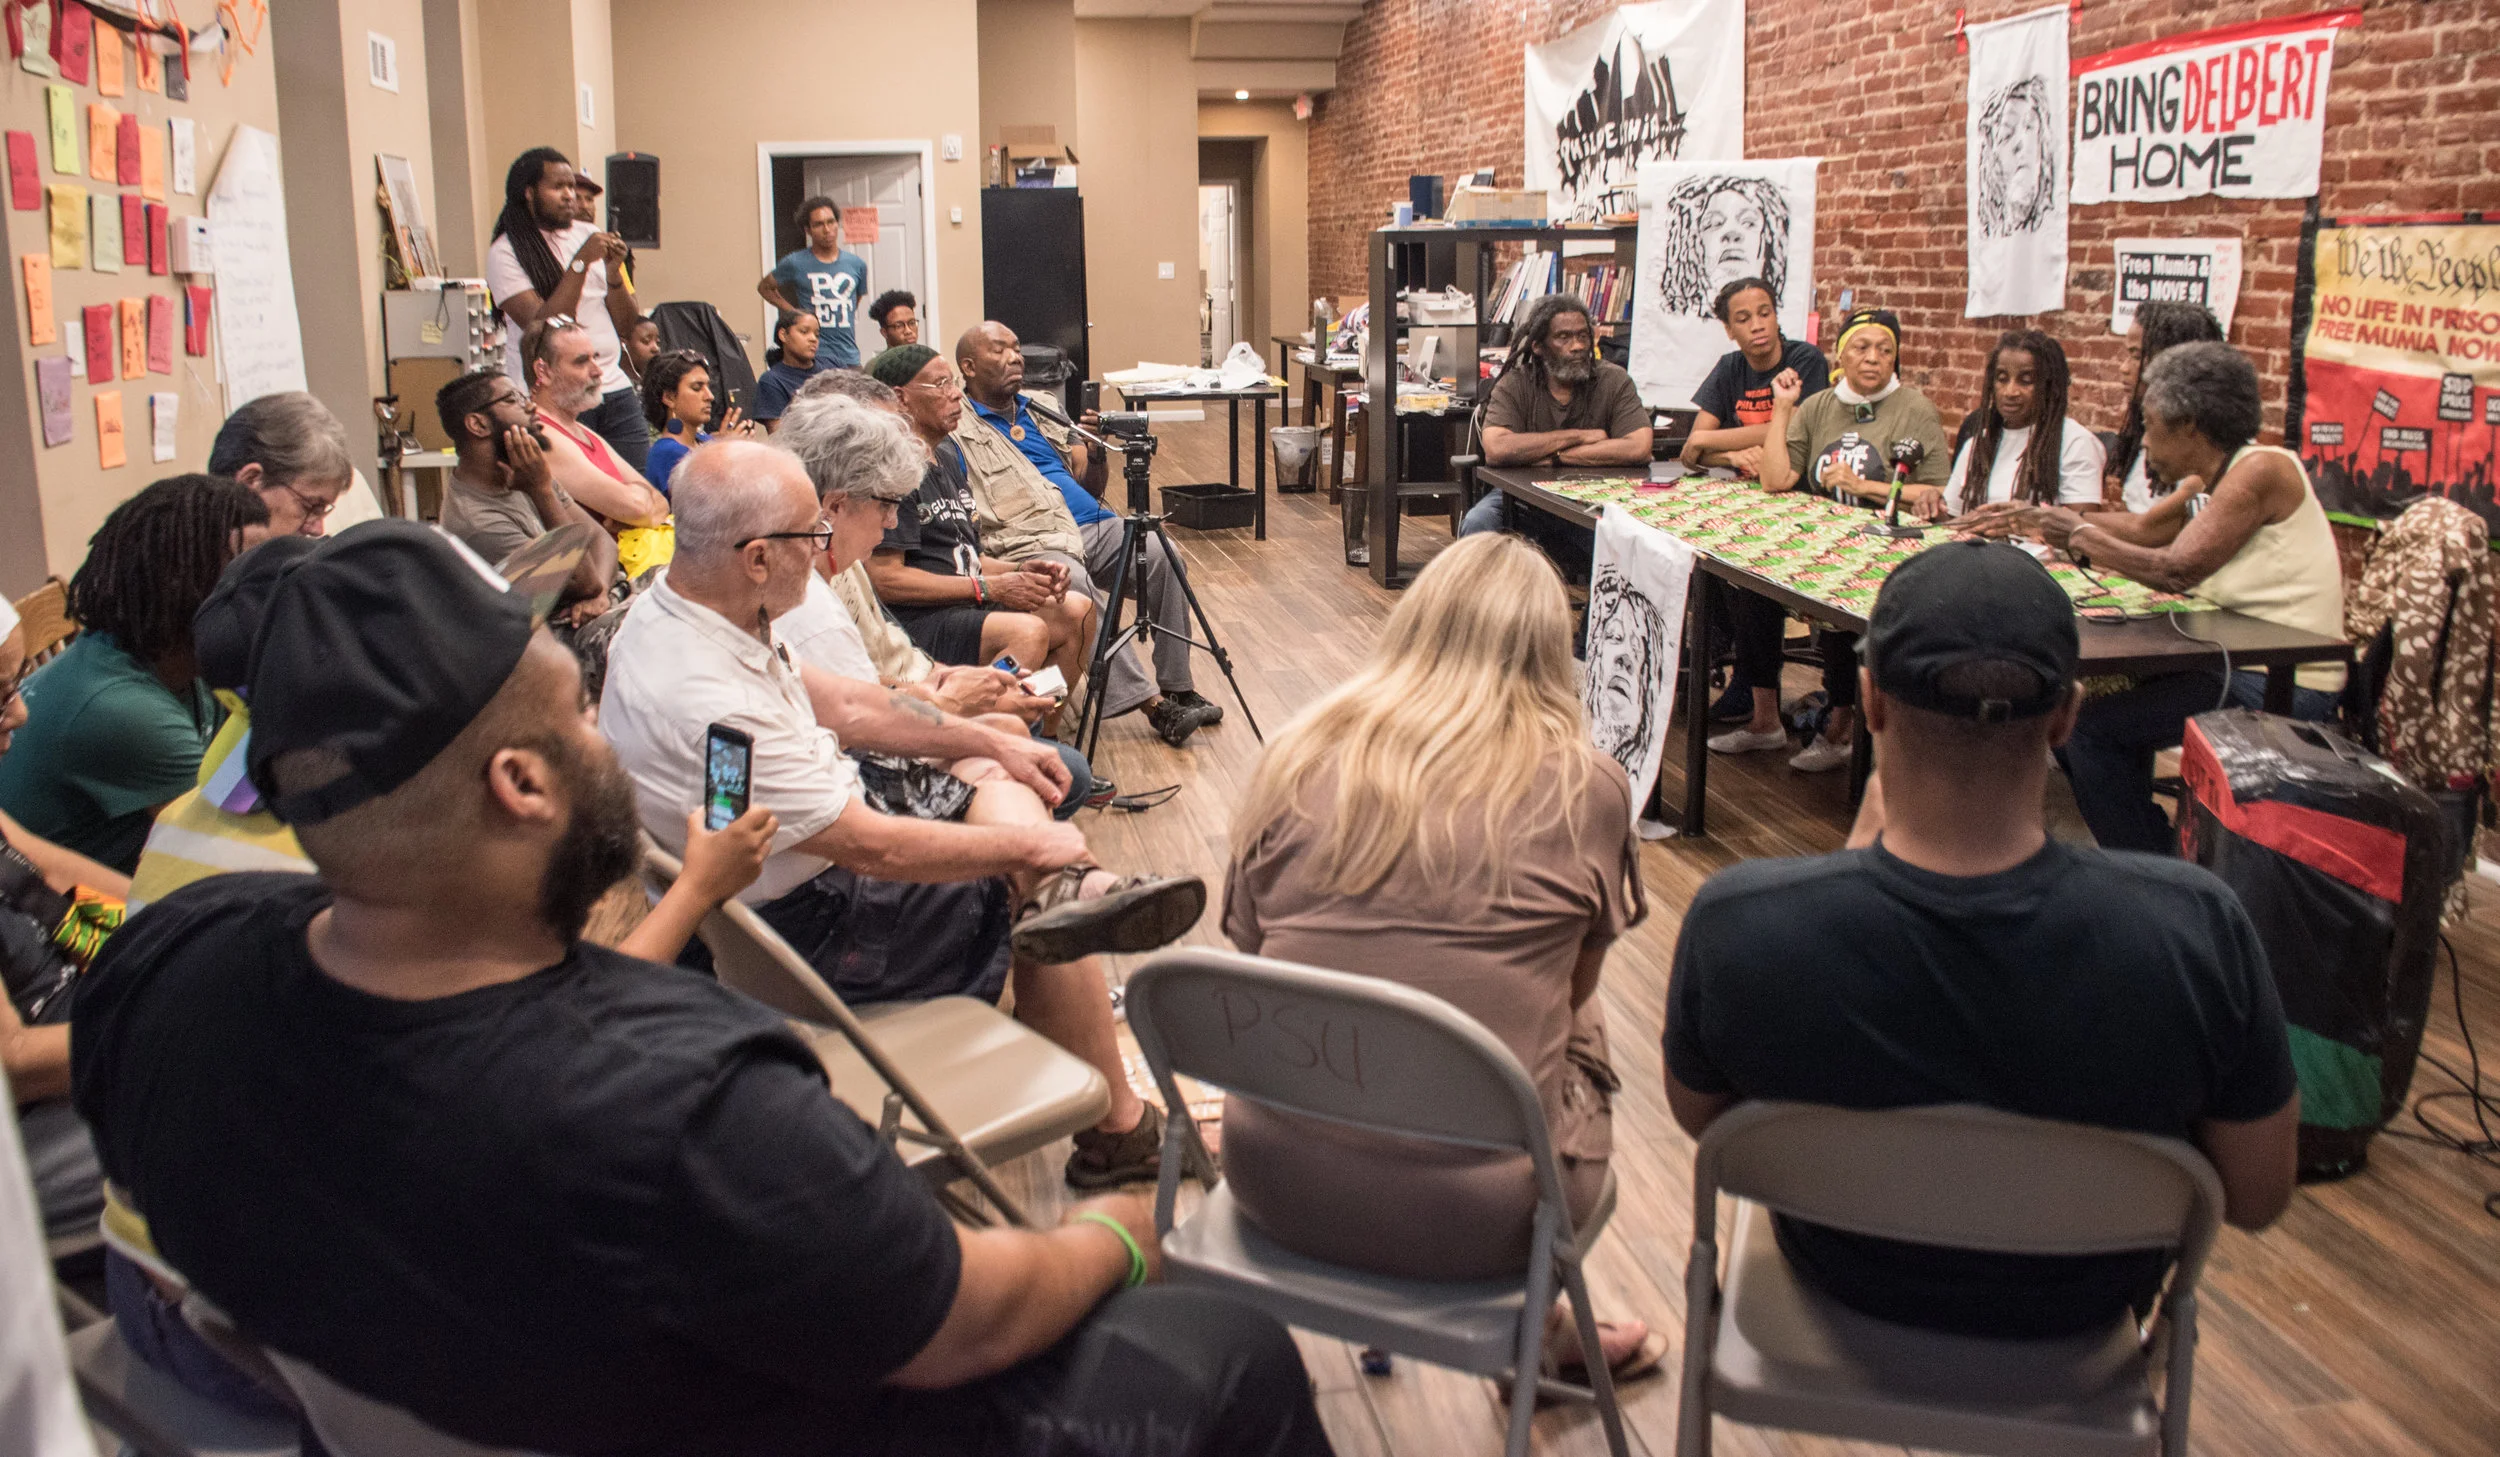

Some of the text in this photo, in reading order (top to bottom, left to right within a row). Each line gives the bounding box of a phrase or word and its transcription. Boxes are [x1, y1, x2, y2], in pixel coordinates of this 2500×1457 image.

[2081, 39, 2329, 141] BRING DELBERT
[2109, 135, 2255, 193] HOME
[2121, 254, 2210, 277] Free Mumia &
[2336, 230, 2500, 304] We the Peopl
[807, 271, 856, 300] PO
[2126, 279, 2149, 299] the
[2150, 280, 2188, 301] MOVE
[811, 297, 853, 328] ET
[2321, 294, 2500, 335] NO LIFE IN PRISO
[2315, 318, 2355, 341] FREE
[2356, 323, 2439, 354] MUMIA
